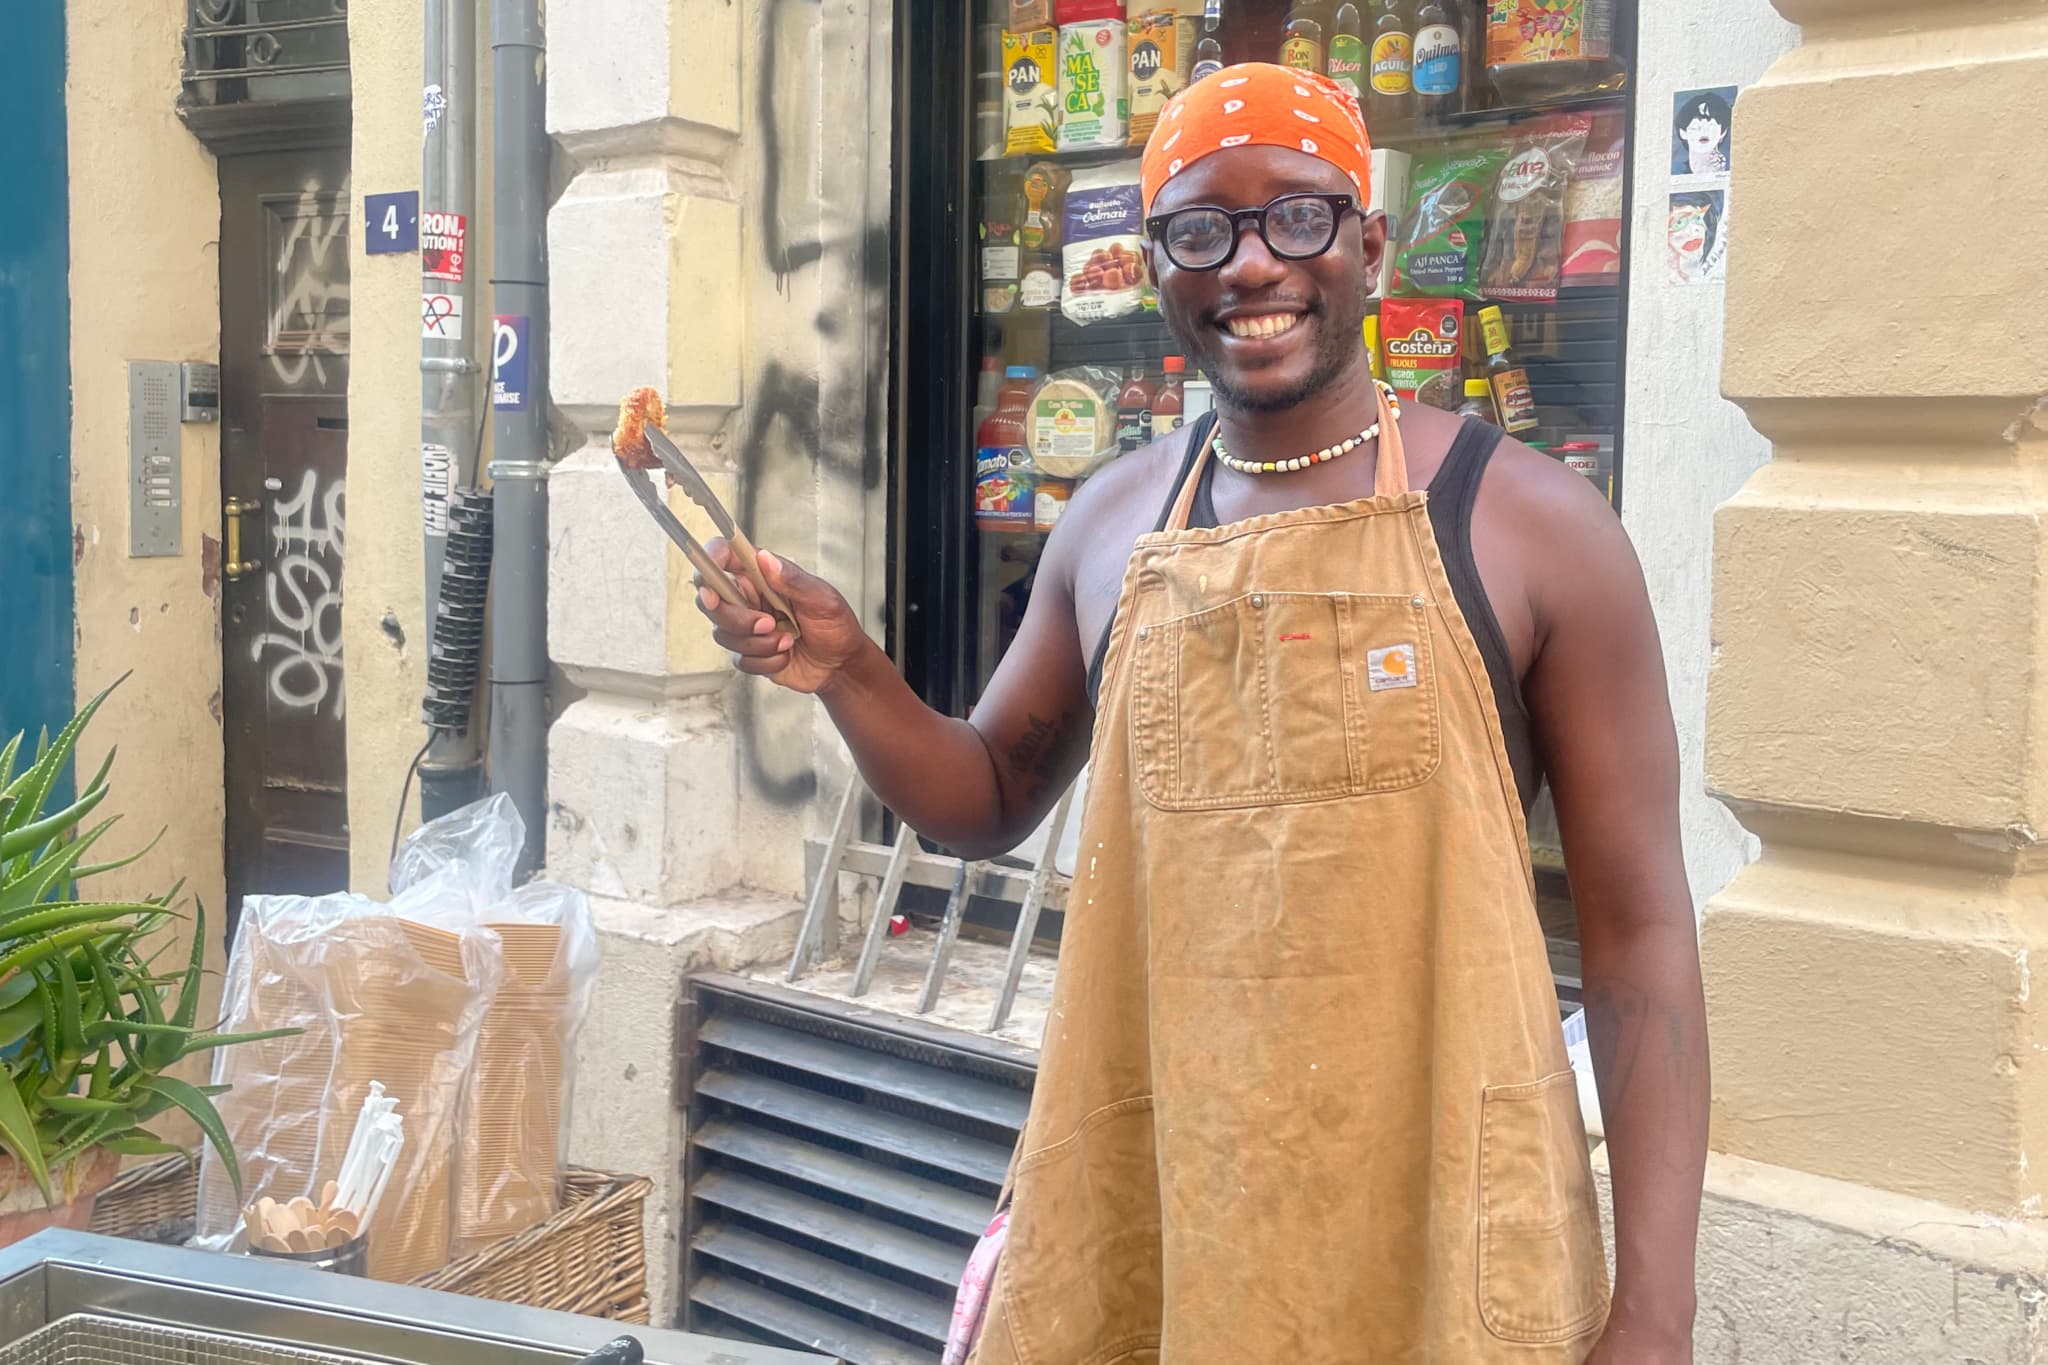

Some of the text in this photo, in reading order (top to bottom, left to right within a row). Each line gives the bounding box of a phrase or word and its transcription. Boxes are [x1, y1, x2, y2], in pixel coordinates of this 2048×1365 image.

[1067, 53, 1093, 75] MA
[1131, 50, 1161, 71] PAN
[1008, 65, 1041, 86] PAN
[1075, 73, 1099, 92] SE
[1066, 92, 1089, 113] CA
[382, 204, 399, 240] 4
[1429, 254, 1460, 265] PANCA
[1389, 340, 1452, 354] Costeña
[1414, 331, 1428, 342] La
